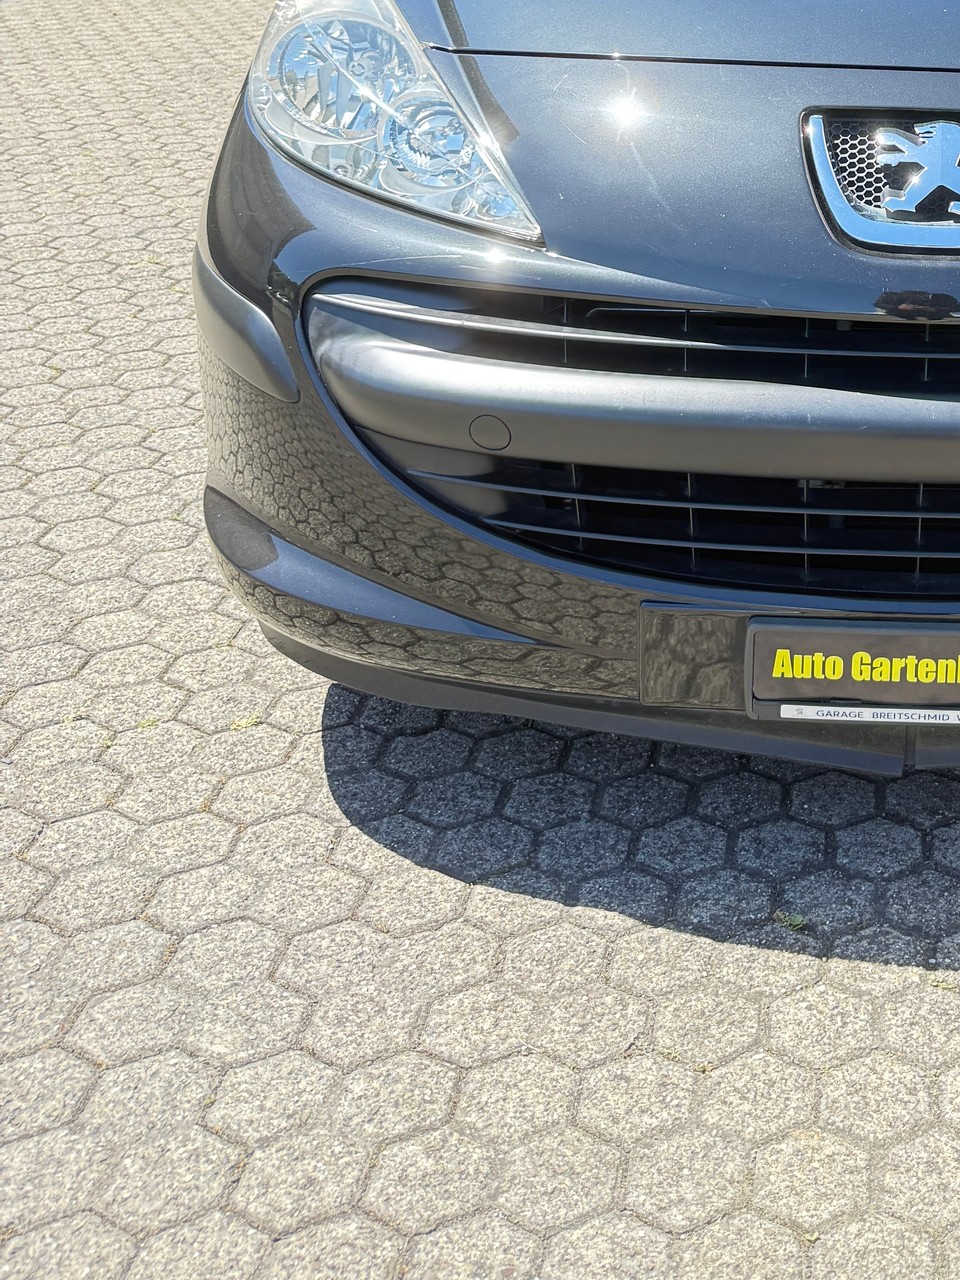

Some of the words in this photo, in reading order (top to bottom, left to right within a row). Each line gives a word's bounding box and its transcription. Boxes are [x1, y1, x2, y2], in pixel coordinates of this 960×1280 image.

[772, 648, 844, 680] Auto
[816, 709, 864, 719] GARAGE
[871, 712, 950, 722] BREITSCHMID
